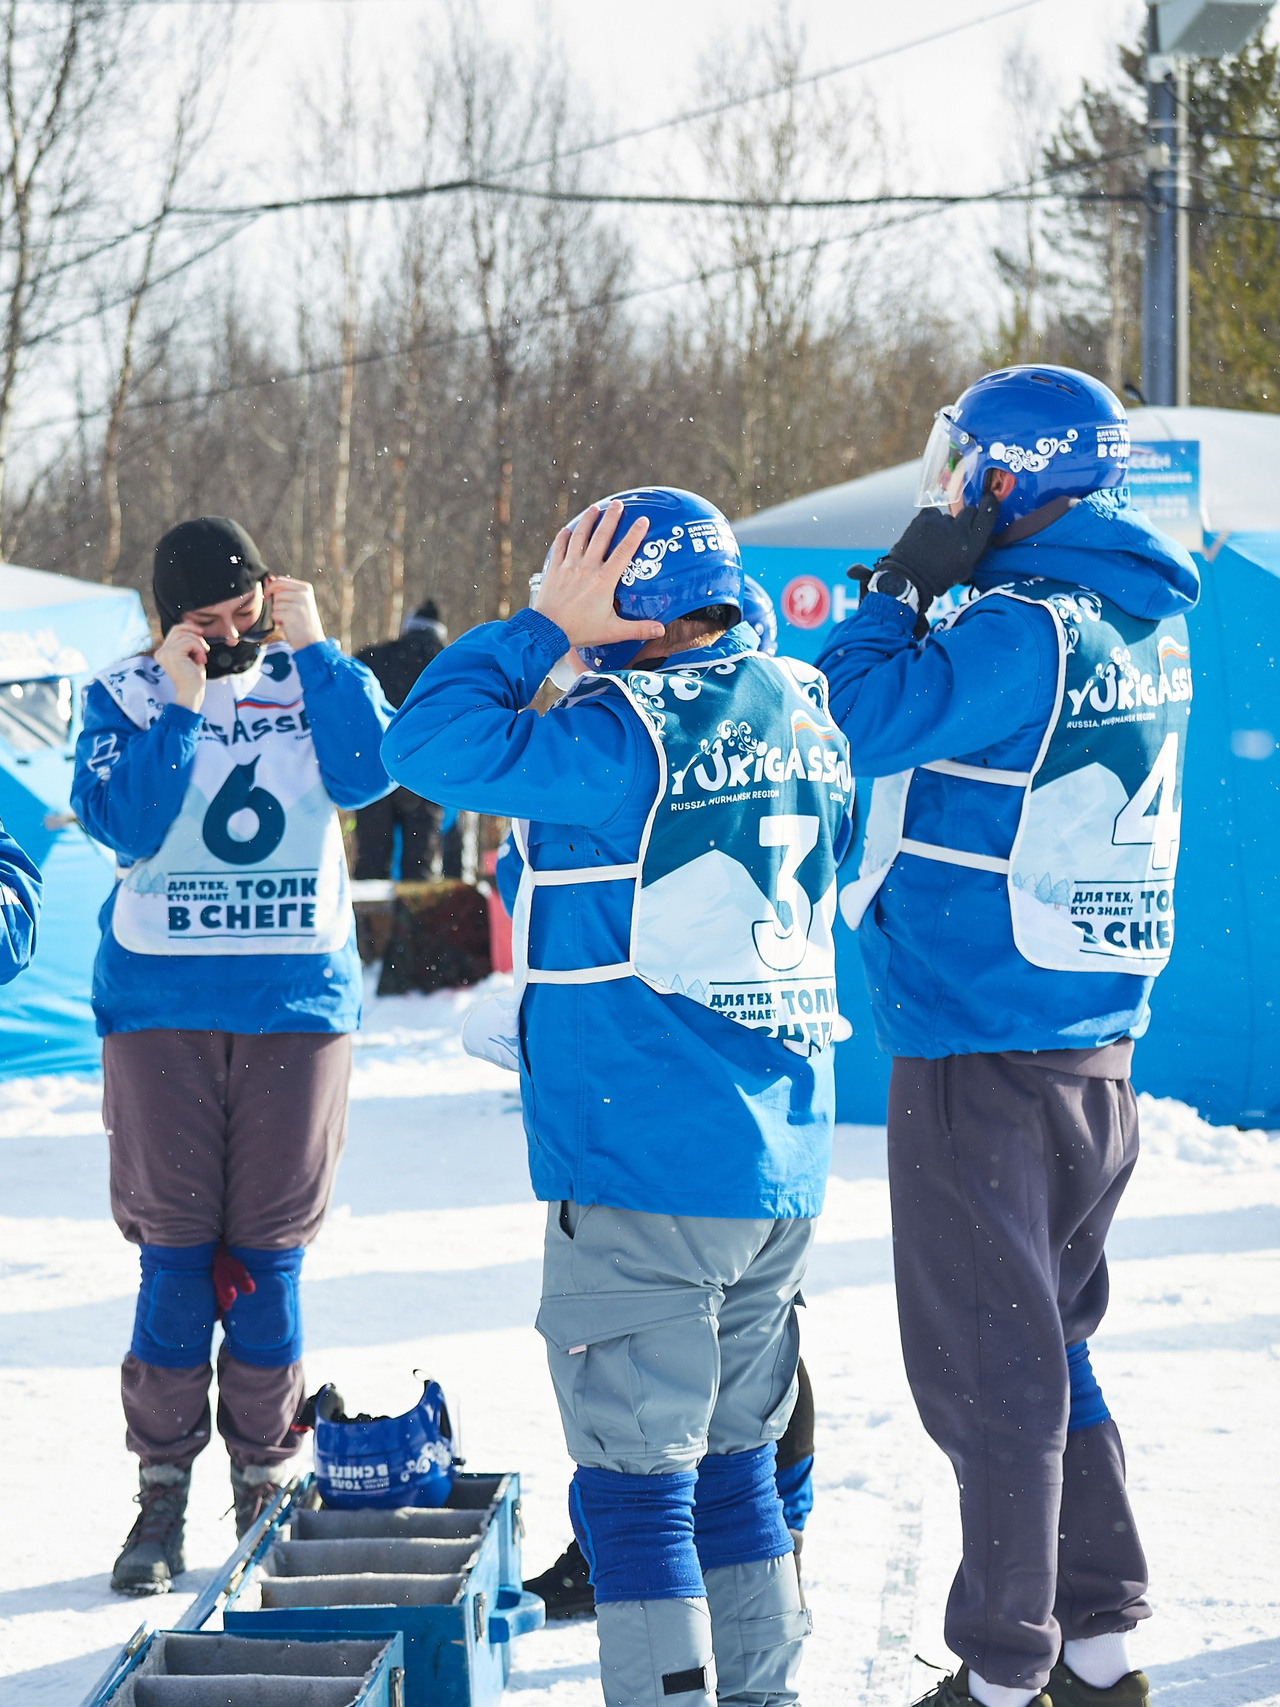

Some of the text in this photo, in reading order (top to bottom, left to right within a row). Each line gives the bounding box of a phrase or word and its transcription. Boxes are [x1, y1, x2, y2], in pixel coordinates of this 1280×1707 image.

[1097, 443, 1108, 457] В
[692, 538, 706, 553] В
[752, 790, 780, 799] REGION
[1112, 732, 1180, 870] 4
[202, 754, 286, 866] 6
[168, 880, 229, 892] ДЛЯ ТЕХ,
[236, 878, 318, 900] ТОЛК
[751, 815, 820, 971] 3
[167, 893, 229, 902] КТО ЗНАЕТ
[1072, 892, 1134, 904] ДЛЯ ТЕХ,
[1140, 890, 1170, 914] ТО
[168, 903, 317, 931] В СНЕГЕ
[1070, 906, 1134, 916] КТО ЗНАЕТ
[1104, 921, 1171, 951] СНЕ
[709, 994, 744, 1008] ДЛЯ
[740, 1009, 777, 1021] ЗНАЕТ
[328, 1463, 389, 1480] В СНЕГЕ
